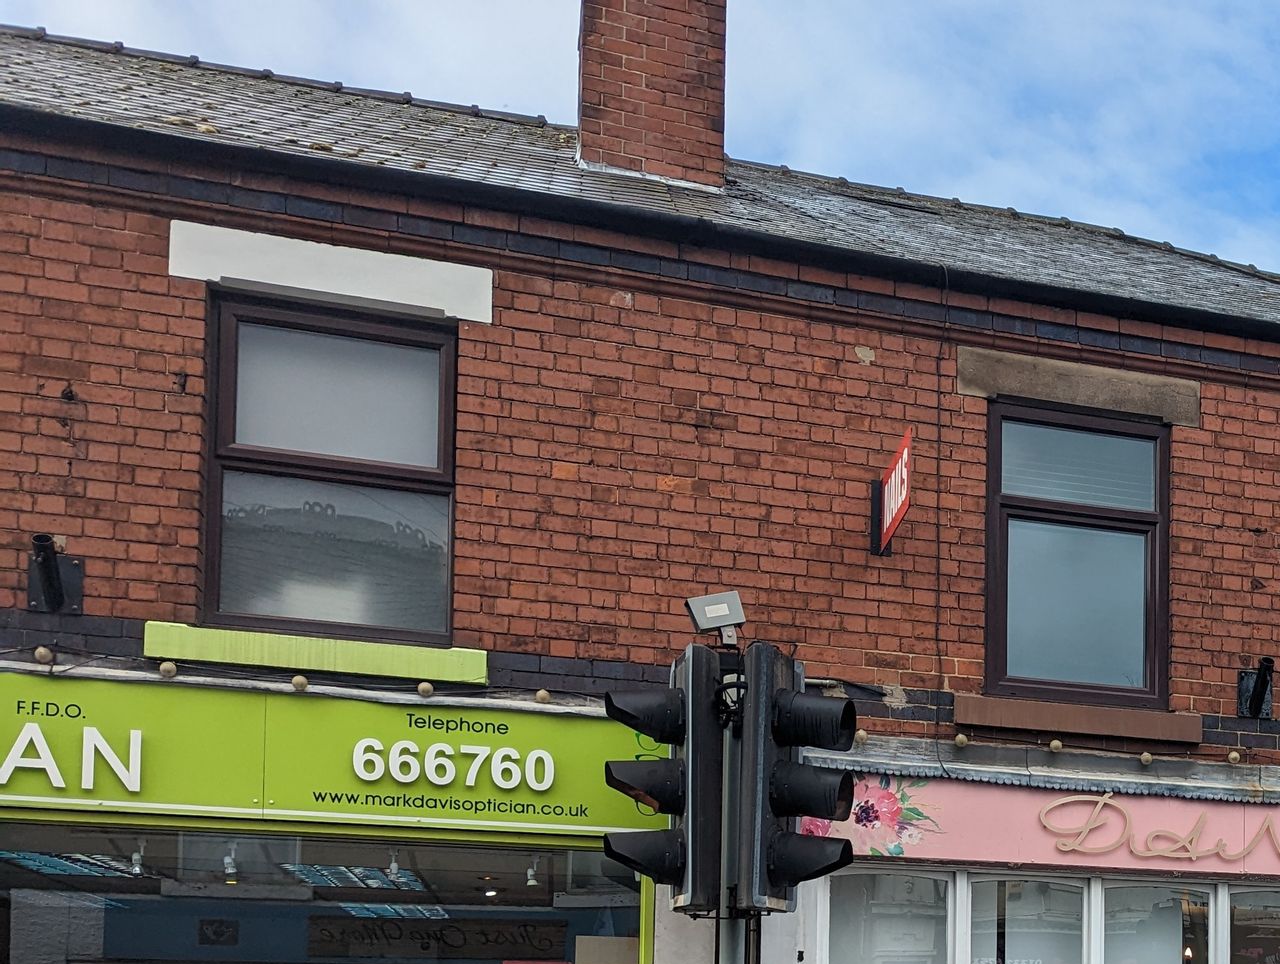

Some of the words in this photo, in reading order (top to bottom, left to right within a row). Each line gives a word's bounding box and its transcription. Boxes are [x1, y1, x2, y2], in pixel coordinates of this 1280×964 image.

[884, 447, 908, 534] NAILS
[16, 700, 86, 719] F.F.D.O.
[406, 713, 509, 735] Telephone
[352, 737, 555, 792] 666760
[312, 791, 589, 818] www.markdavisoptician.co.uk
